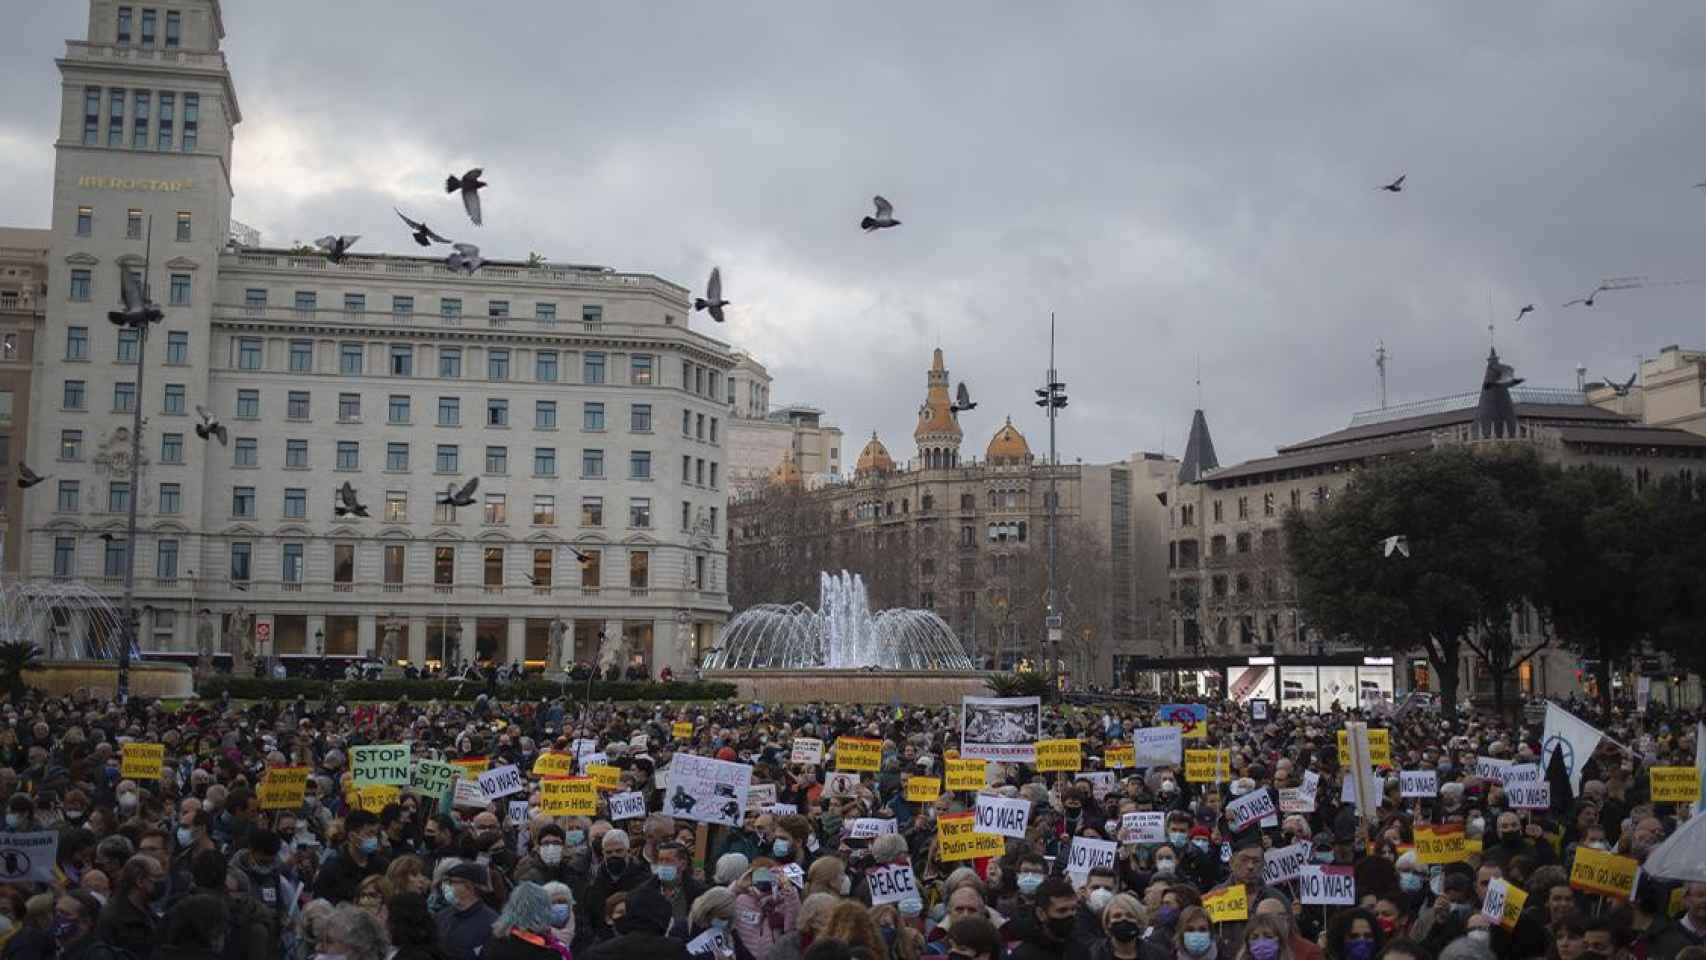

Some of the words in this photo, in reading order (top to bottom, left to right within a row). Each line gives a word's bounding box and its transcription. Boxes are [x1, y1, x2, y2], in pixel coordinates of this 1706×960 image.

[355, 750, 405, 762] STOP
[353, 767, 407, 780] PUTIN
[1477, 763, 1490, 778] NO
[1518, 771, 1537, 782] WAR
[415, 777, 448, 793] PUT
[479, 778, 496, 796] NO
[496, 770, 520, 791] WAR
[1401, 778, 1414, 793] NO
[1416, 778, 1435, 793] WAR
[610, 802, 622, 815] NO
[623, 796, 644, 813] WAR
[1510, 788, 1524, 804] NO
[1525, 788, 1548, 805] WAR
[976, 805, 994, 826] NO
[996, 807, 1024, 831] WAR
[1235, 804, 1249, 823] NO
[1248, 796, 1272, 816] WAR
[1070, 847, 1086, 867] NO
[1088, 848, 1113, 868] WAR
[1263, 860, 1279, 880] NO
[1278, 852, 1304, 875] WAR
[870, 868, 913, 897] PEACE
[1301, 875, 1319, 897] NO
[1321, 875, 1353, 897] WAR
